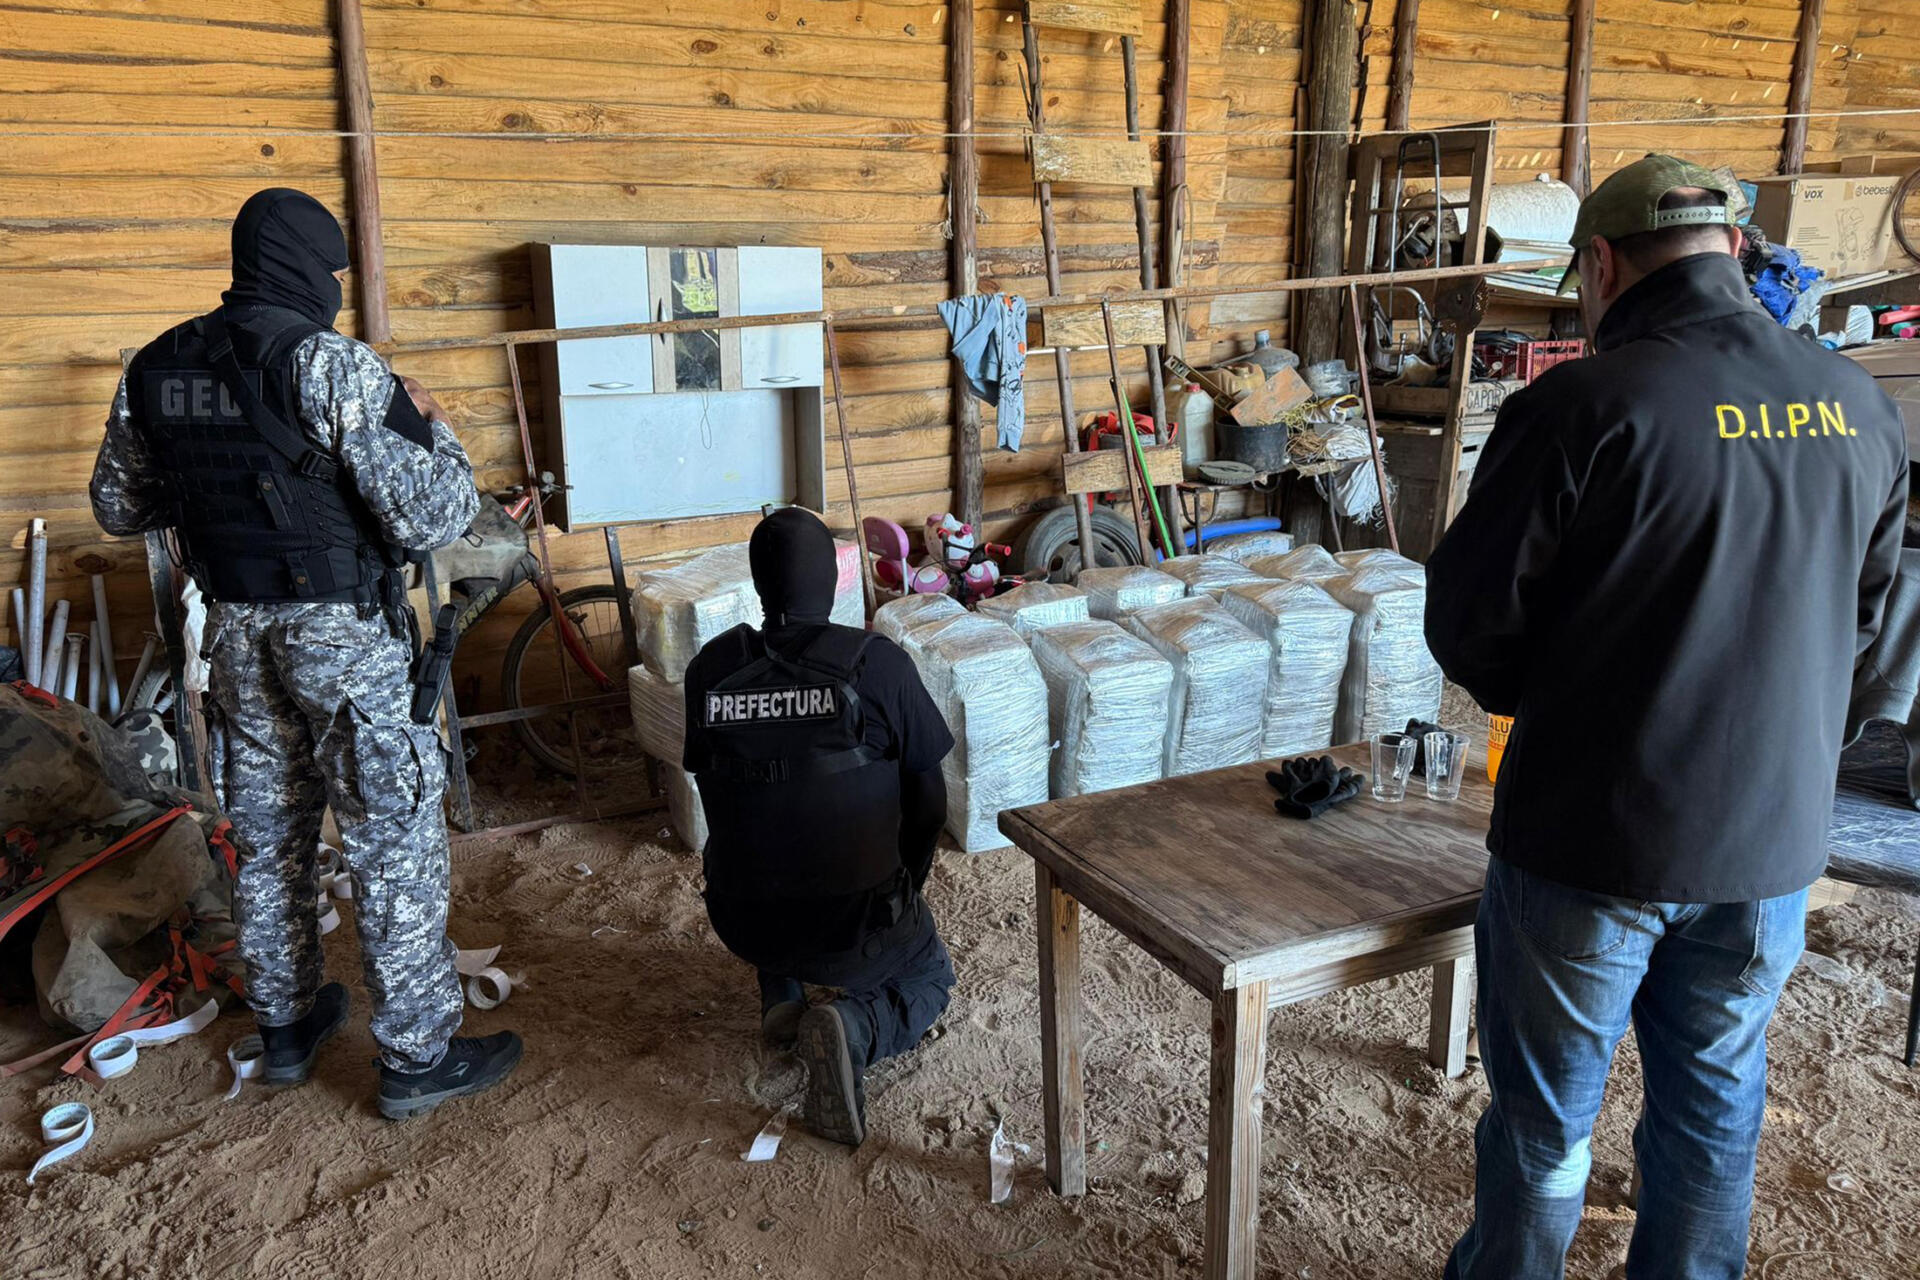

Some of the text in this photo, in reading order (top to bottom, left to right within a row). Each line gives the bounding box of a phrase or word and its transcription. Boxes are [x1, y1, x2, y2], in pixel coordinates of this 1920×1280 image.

[1804, 190, 1824, 199] VOX
[1715, 401, 1857, 439] D.I.P.N.
[709, 687, 836, 723] PREFECTURA
